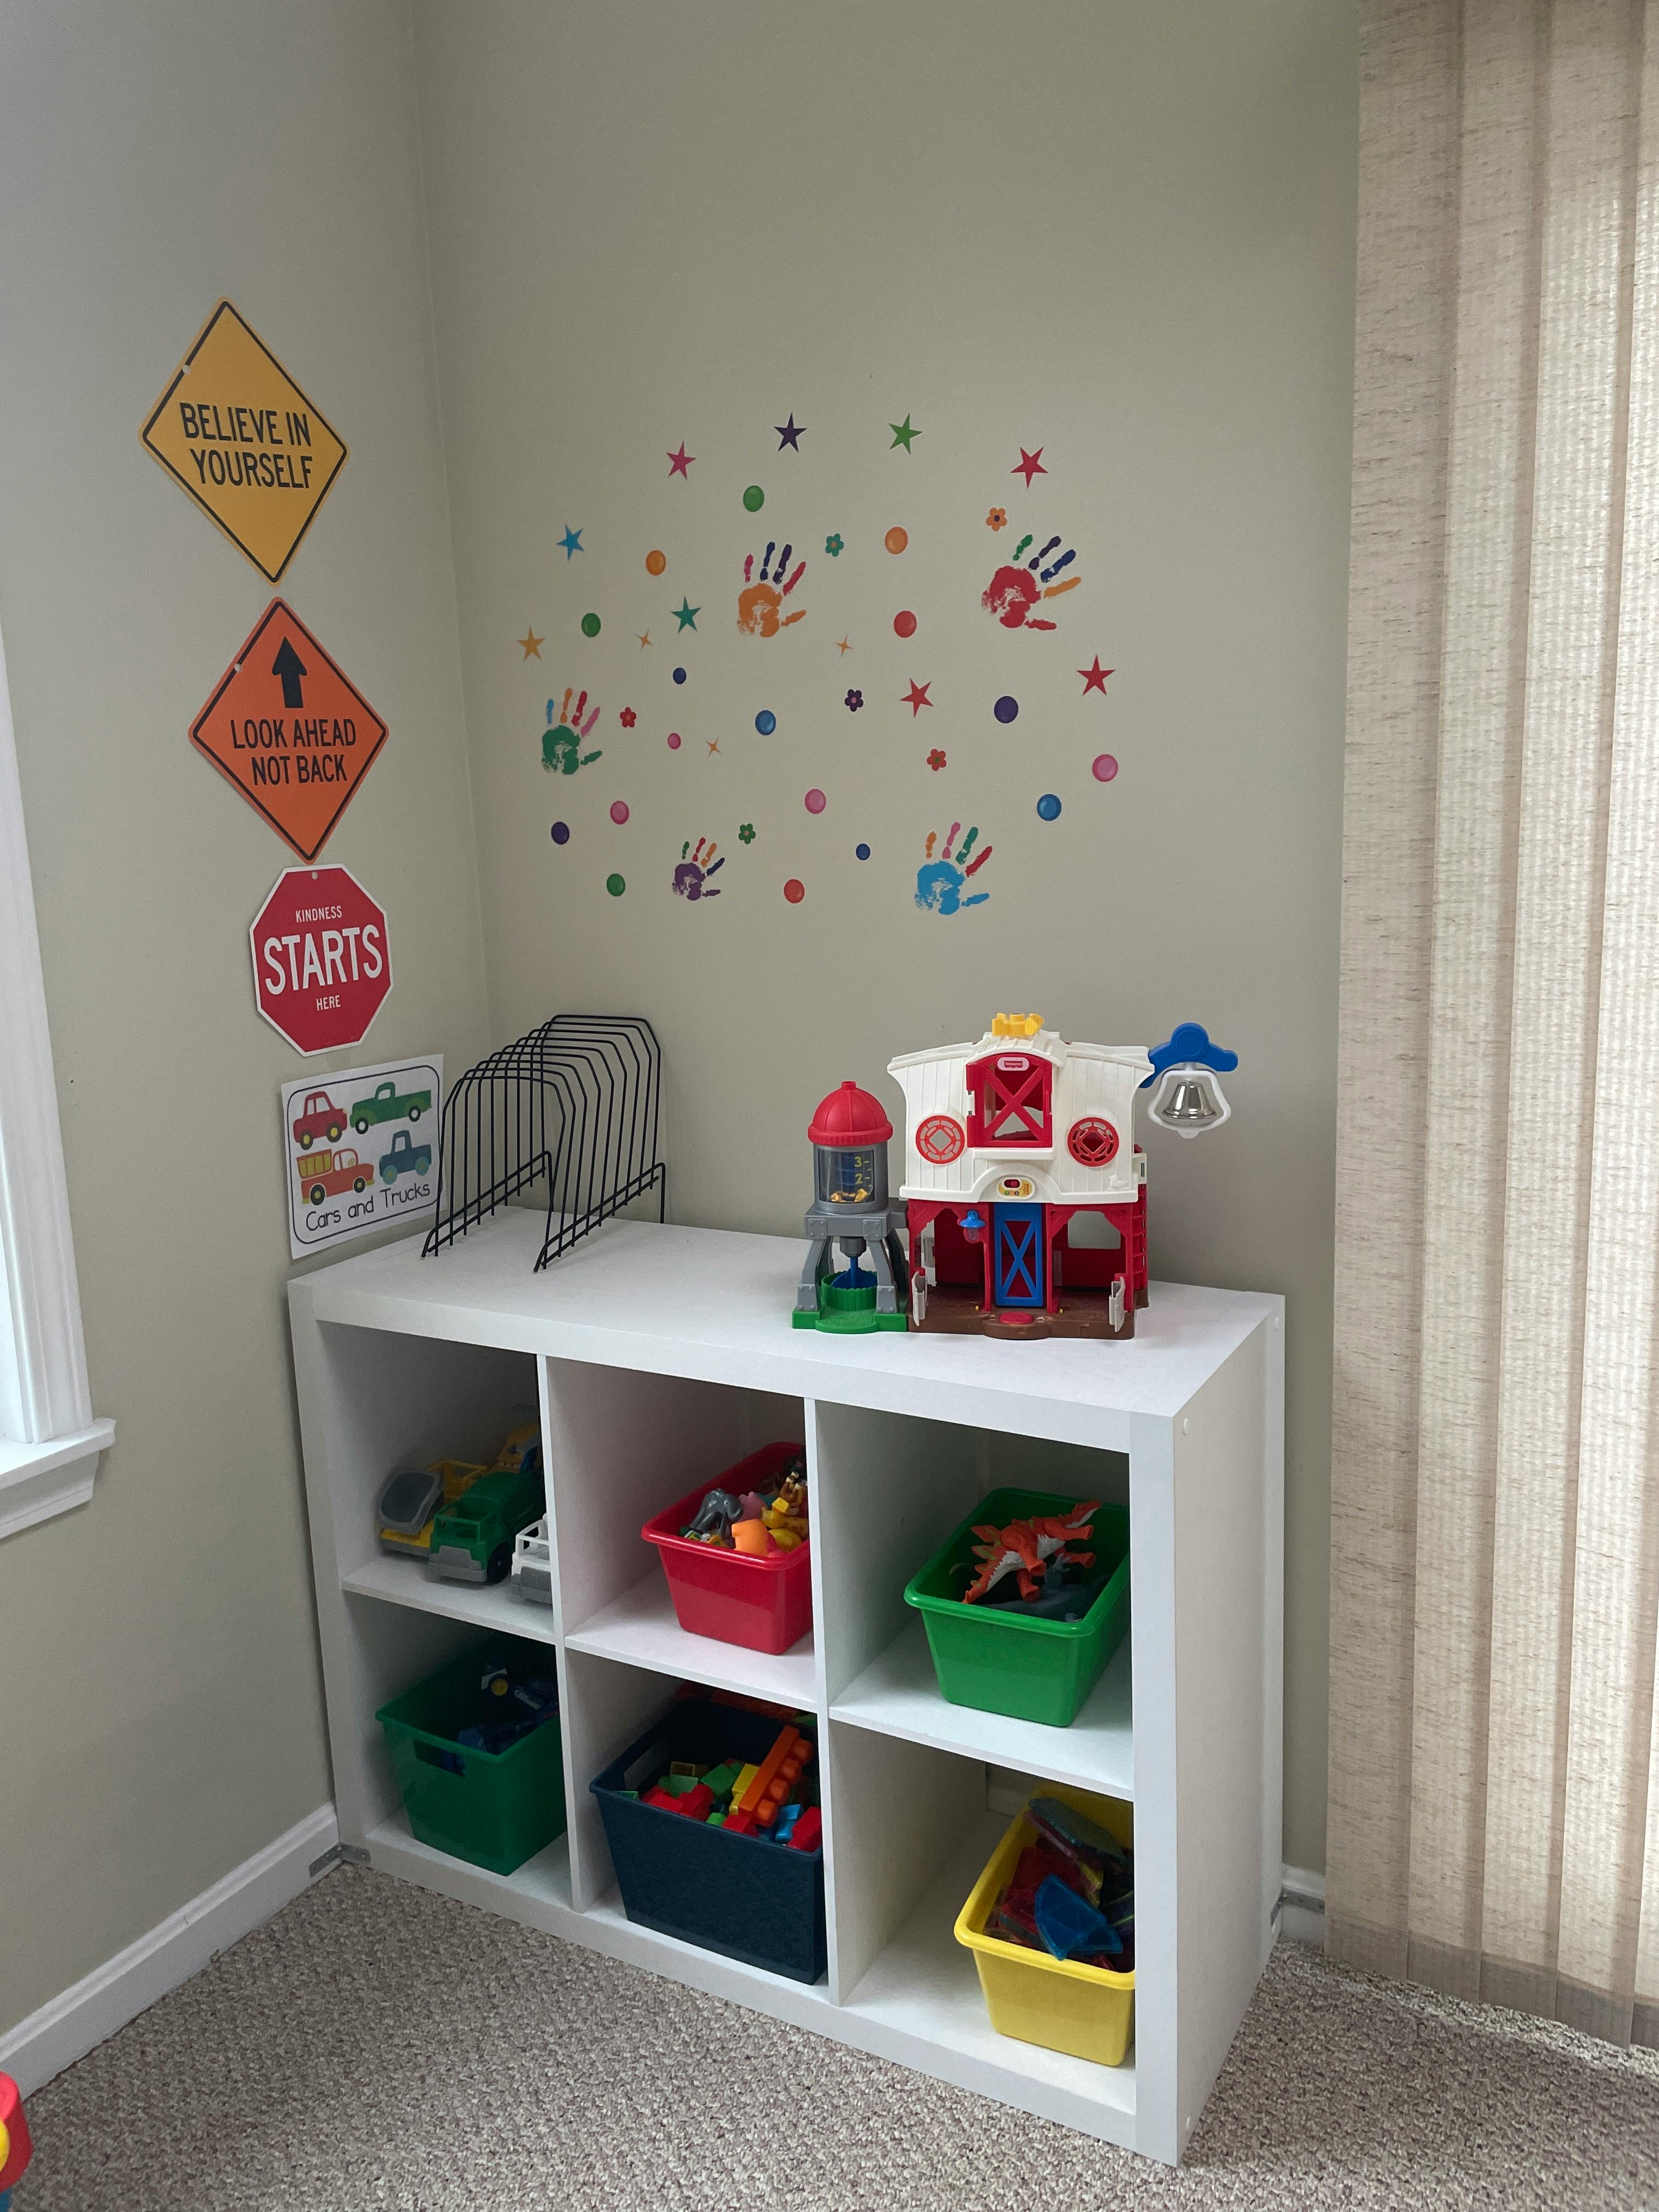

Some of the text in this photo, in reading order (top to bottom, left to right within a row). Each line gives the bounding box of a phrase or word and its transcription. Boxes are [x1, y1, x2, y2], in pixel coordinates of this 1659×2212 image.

[179, 402, 312, 447] BELIEVE IN
[189, 448, 313, 489] YOURSELF
[230, 719, 357, 749] LOOK AHEAD
[251, 754, 347, 786] NOT BACK
[295, 905, 342, 923] KINDNESS
[264, 924, 382, 995] STARTS
[316, 995, 341, 1011] HERE
[854, 1156, 862, 1167] 3
[855, 1173, 864, 1184] 2
[306, 1182, 431, 1232] Cars and Trucks
